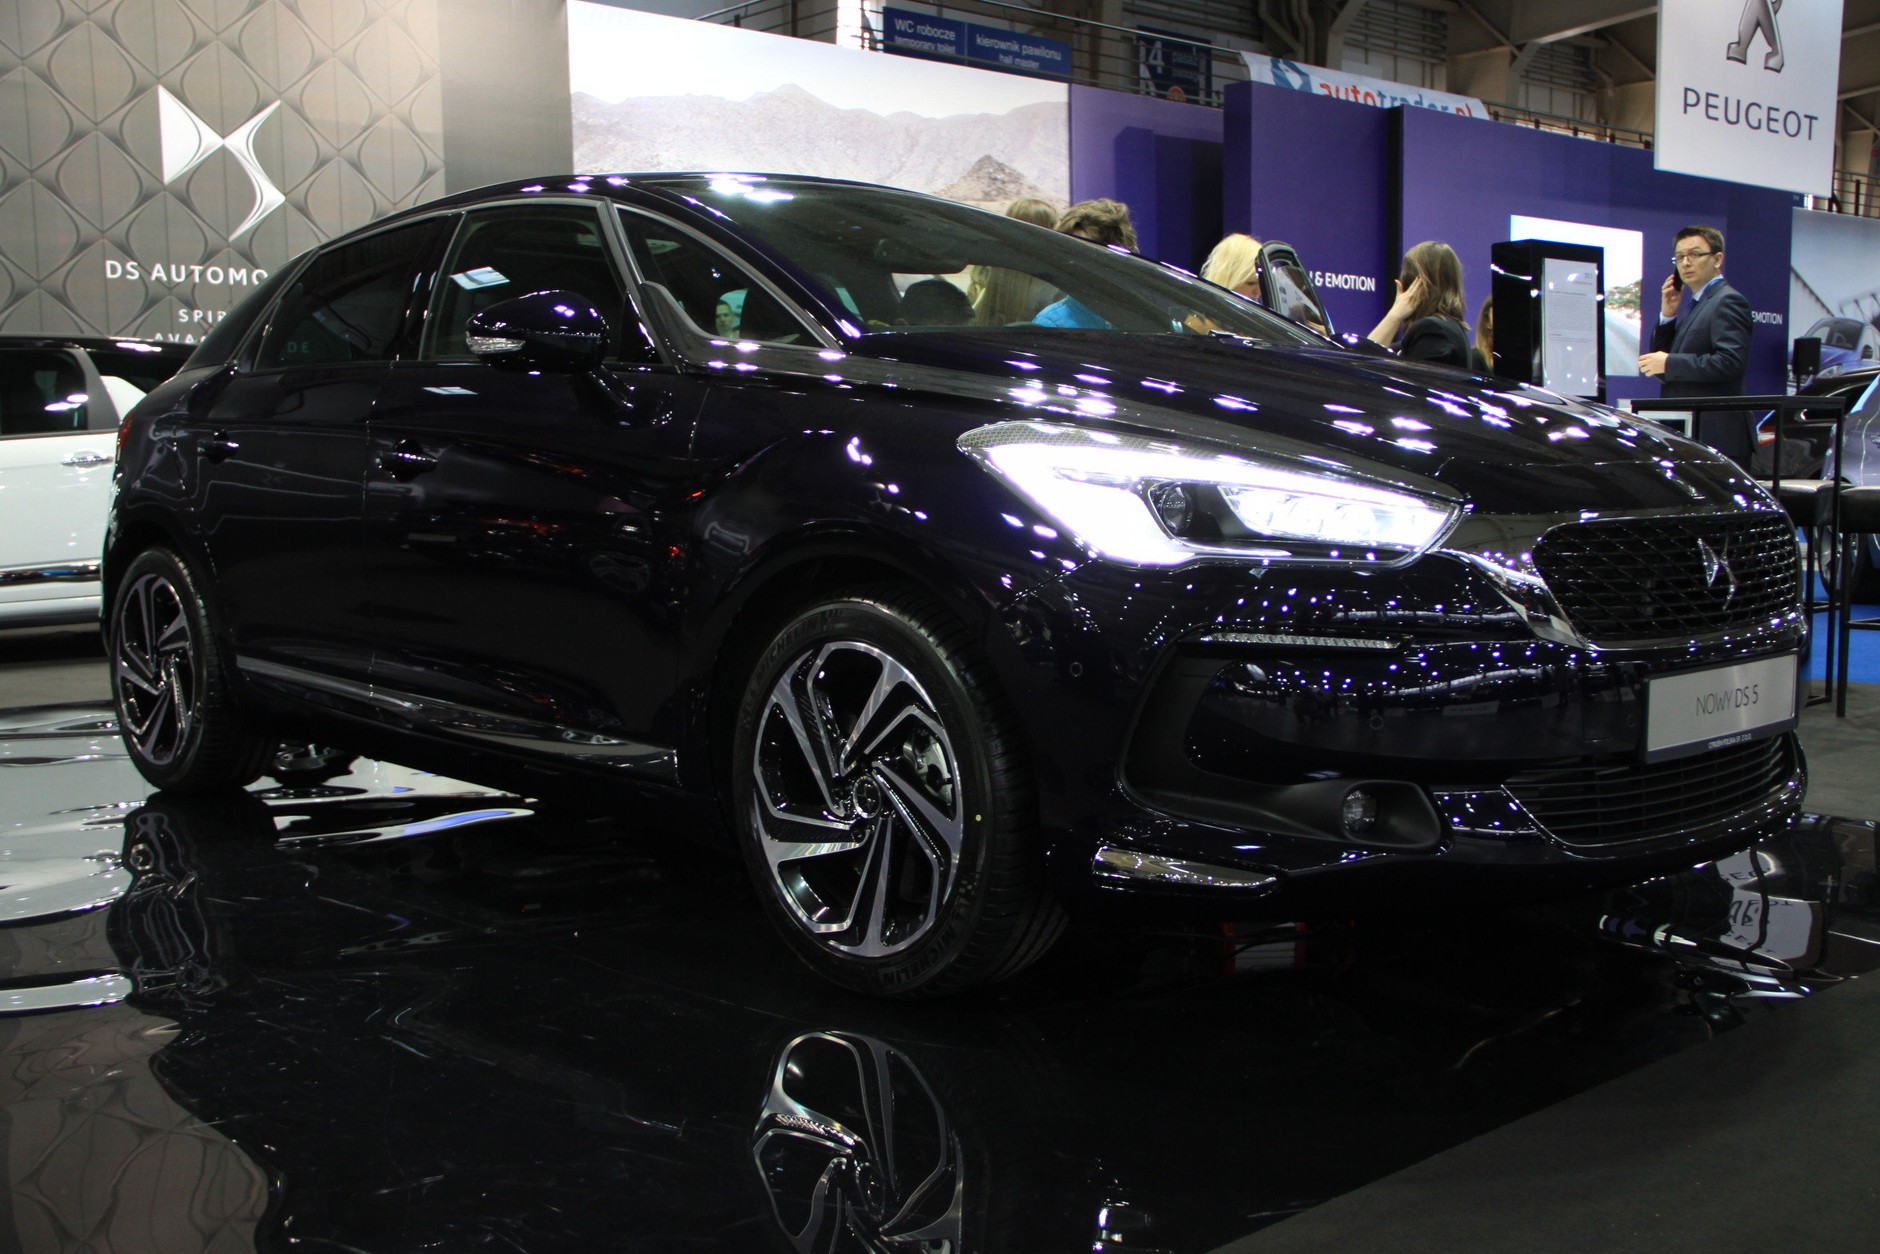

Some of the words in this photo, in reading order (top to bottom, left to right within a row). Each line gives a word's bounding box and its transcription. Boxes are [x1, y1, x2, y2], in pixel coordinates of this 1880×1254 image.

[894, 18, 914, 33] WC
[916, 24, 956, 40] robocze
[976, 33, 1020, 53] kierownik
[1022, 45, 1062, 60] pawilonu
[999, 53, 1013, 65] hall
[1683, 87, 1818, 140] PEUGEOT
[105, 260, 140, 280] DS
[150, 263, 269, 286] AUTOMO
[1314, 271, 1324, 286] &
[1325, 272, 1376, 291] EMOTION
[1751, 310, 1783, 325] EMOTION
[1696, 689, 1734, 717] NOWY
[1735, 686, 1750, 708] DS
[1752, 684, 1759, 704] 5
[882, 922, 958, 987] MICHELIN
